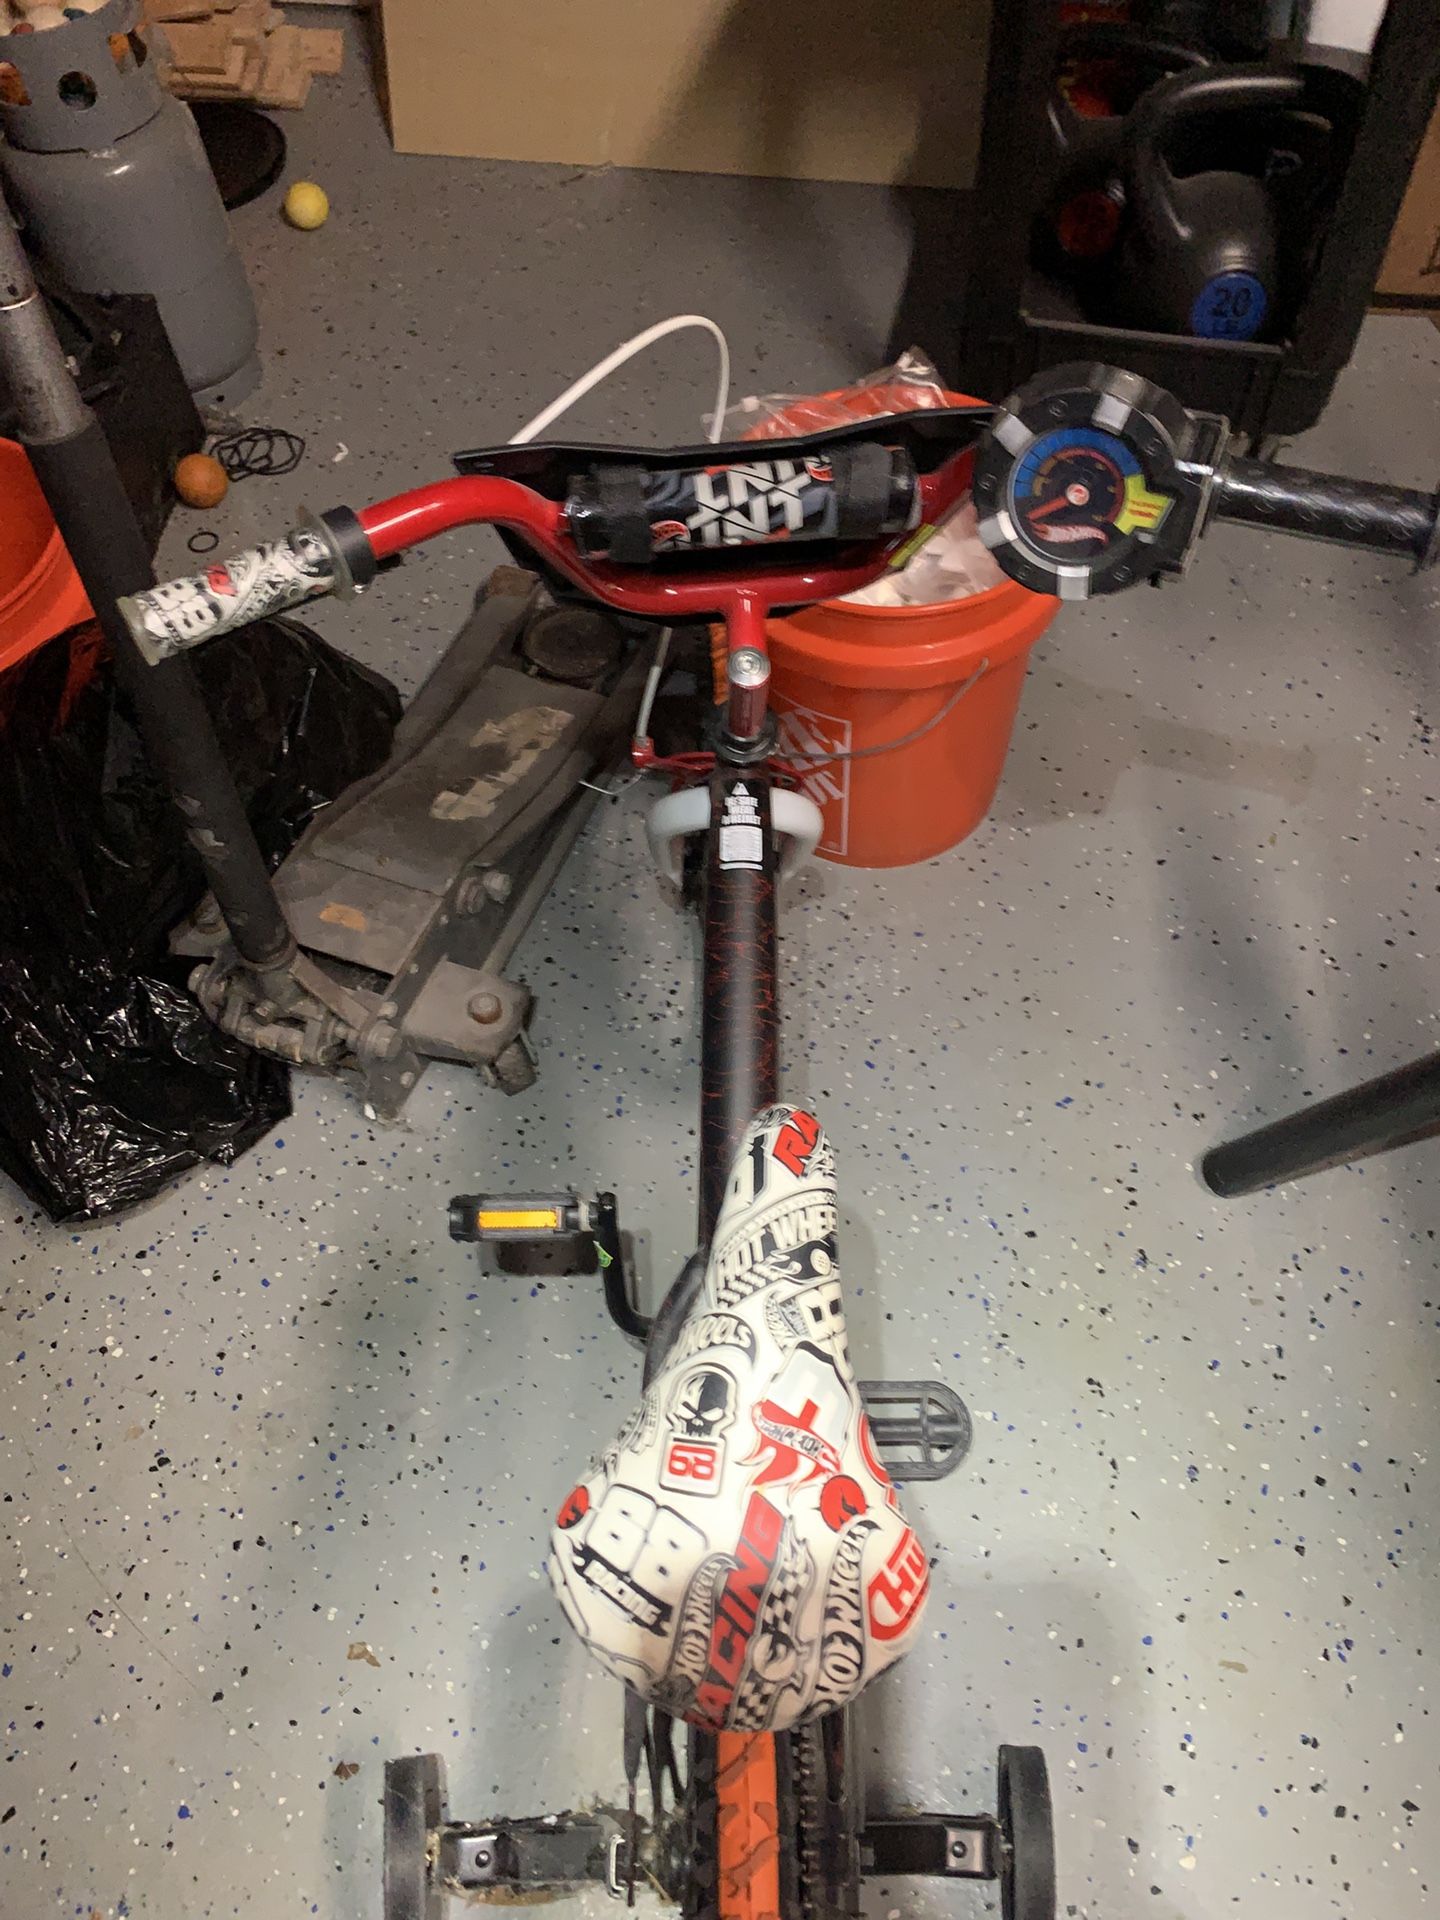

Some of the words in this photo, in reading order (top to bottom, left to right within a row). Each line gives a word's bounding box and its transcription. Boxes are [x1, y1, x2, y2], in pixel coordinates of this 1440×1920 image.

[1211, 287, 1251, 317] 20
[824, 1524, 874, 1643] WHEELS
[673, 1630, 711, 1685] HOT
[812, 1631, 864, 1705] HOT
